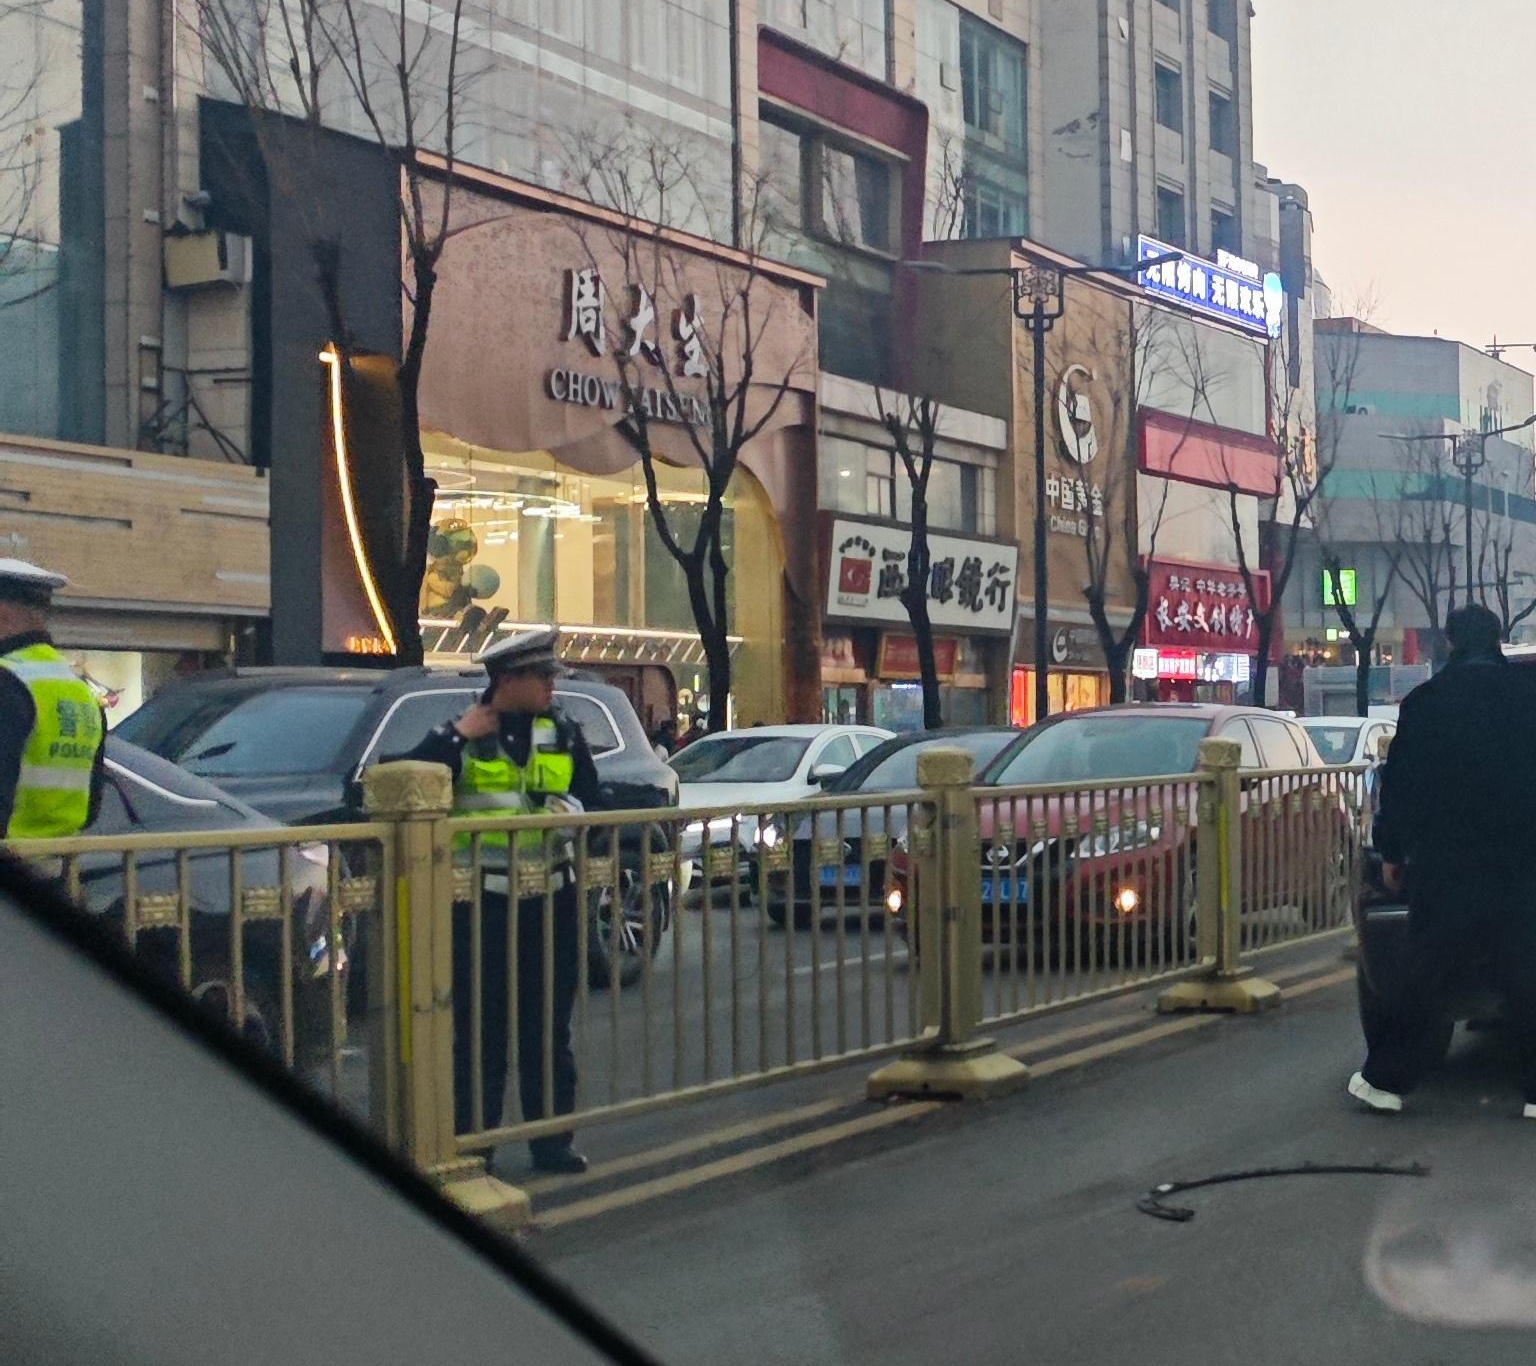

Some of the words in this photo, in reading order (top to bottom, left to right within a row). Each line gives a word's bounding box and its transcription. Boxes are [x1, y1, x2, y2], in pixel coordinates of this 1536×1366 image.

[564, 268, 709, 378] 周大生
[550, 368, 620, 411] CHOW
[1045, 475, 1103, 516] 中国黄金
[877, 547, 1011, 613] 西眼镜行
